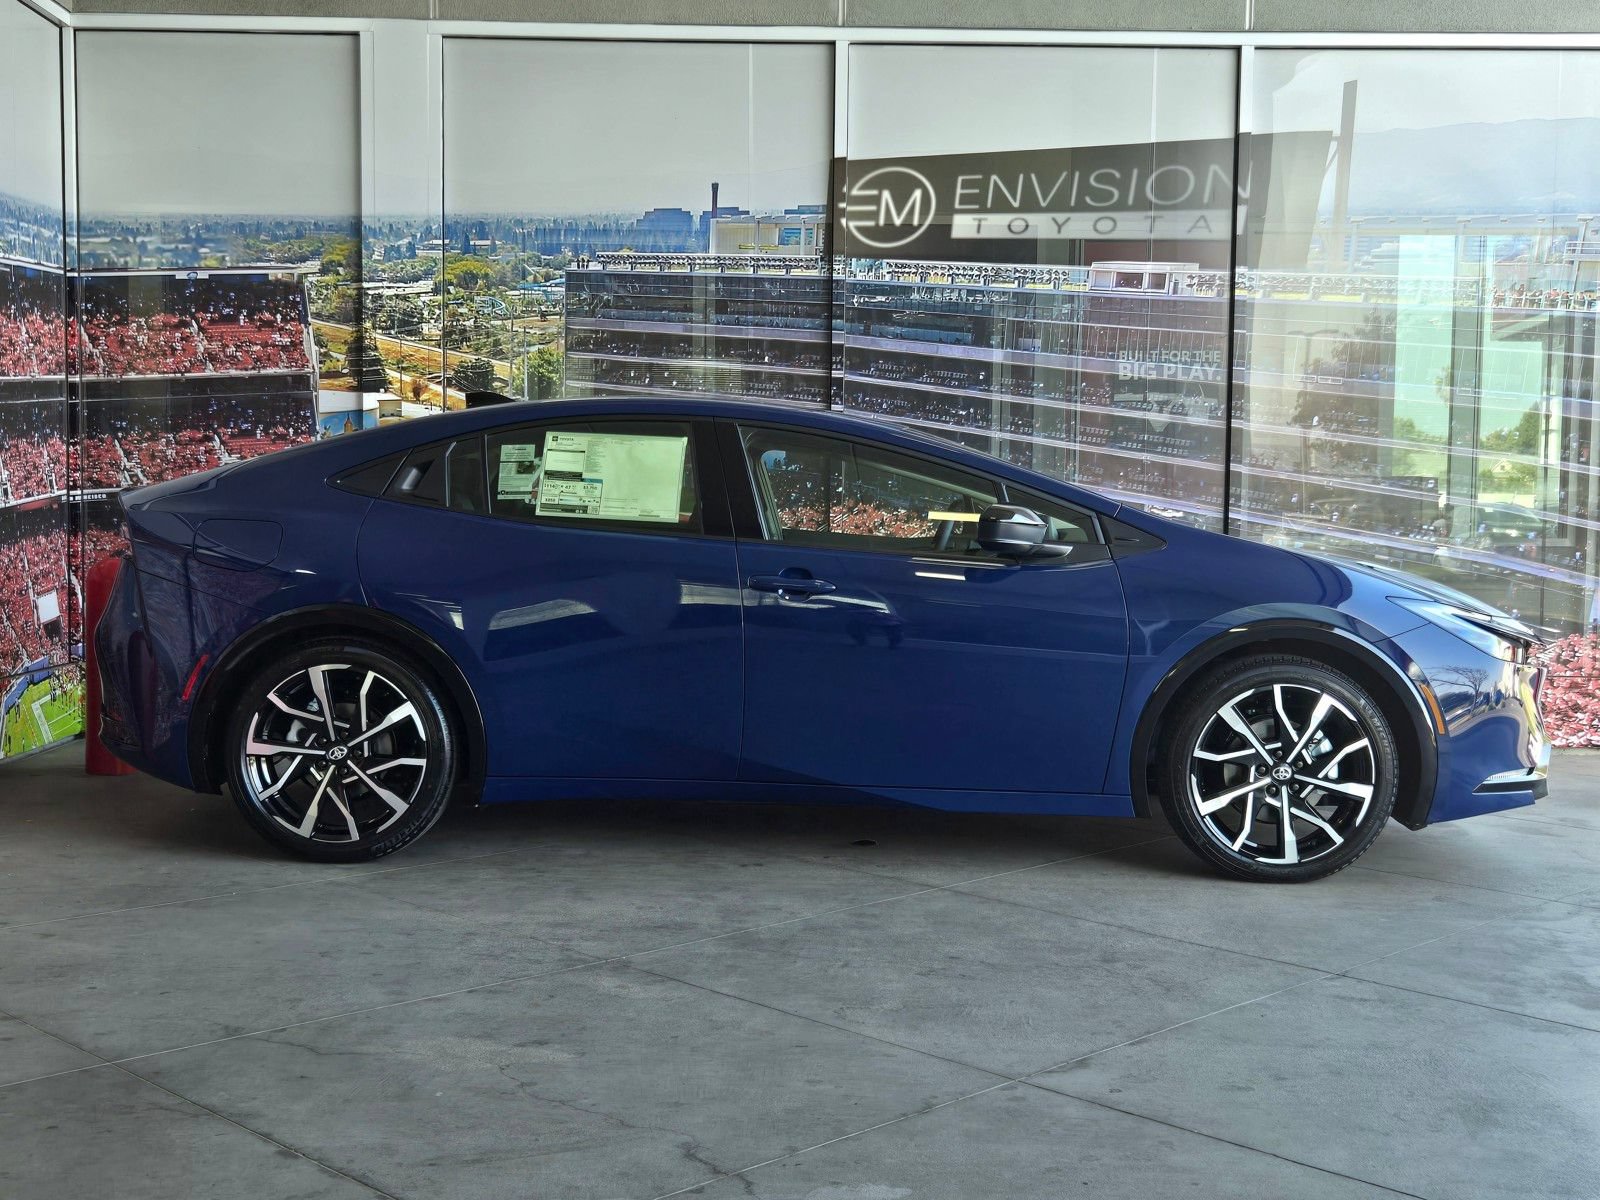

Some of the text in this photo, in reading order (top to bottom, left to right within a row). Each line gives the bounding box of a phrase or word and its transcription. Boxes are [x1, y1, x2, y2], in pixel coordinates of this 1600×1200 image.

[954, 161, 1253, 210] ENVISION
[971, 213, 1213, 236] TOYOTA
[1162, 350, 1190, 361] FOR
[1191, 350, 1221, 362] THE
[1119, 363, 1157, 380] BIG
